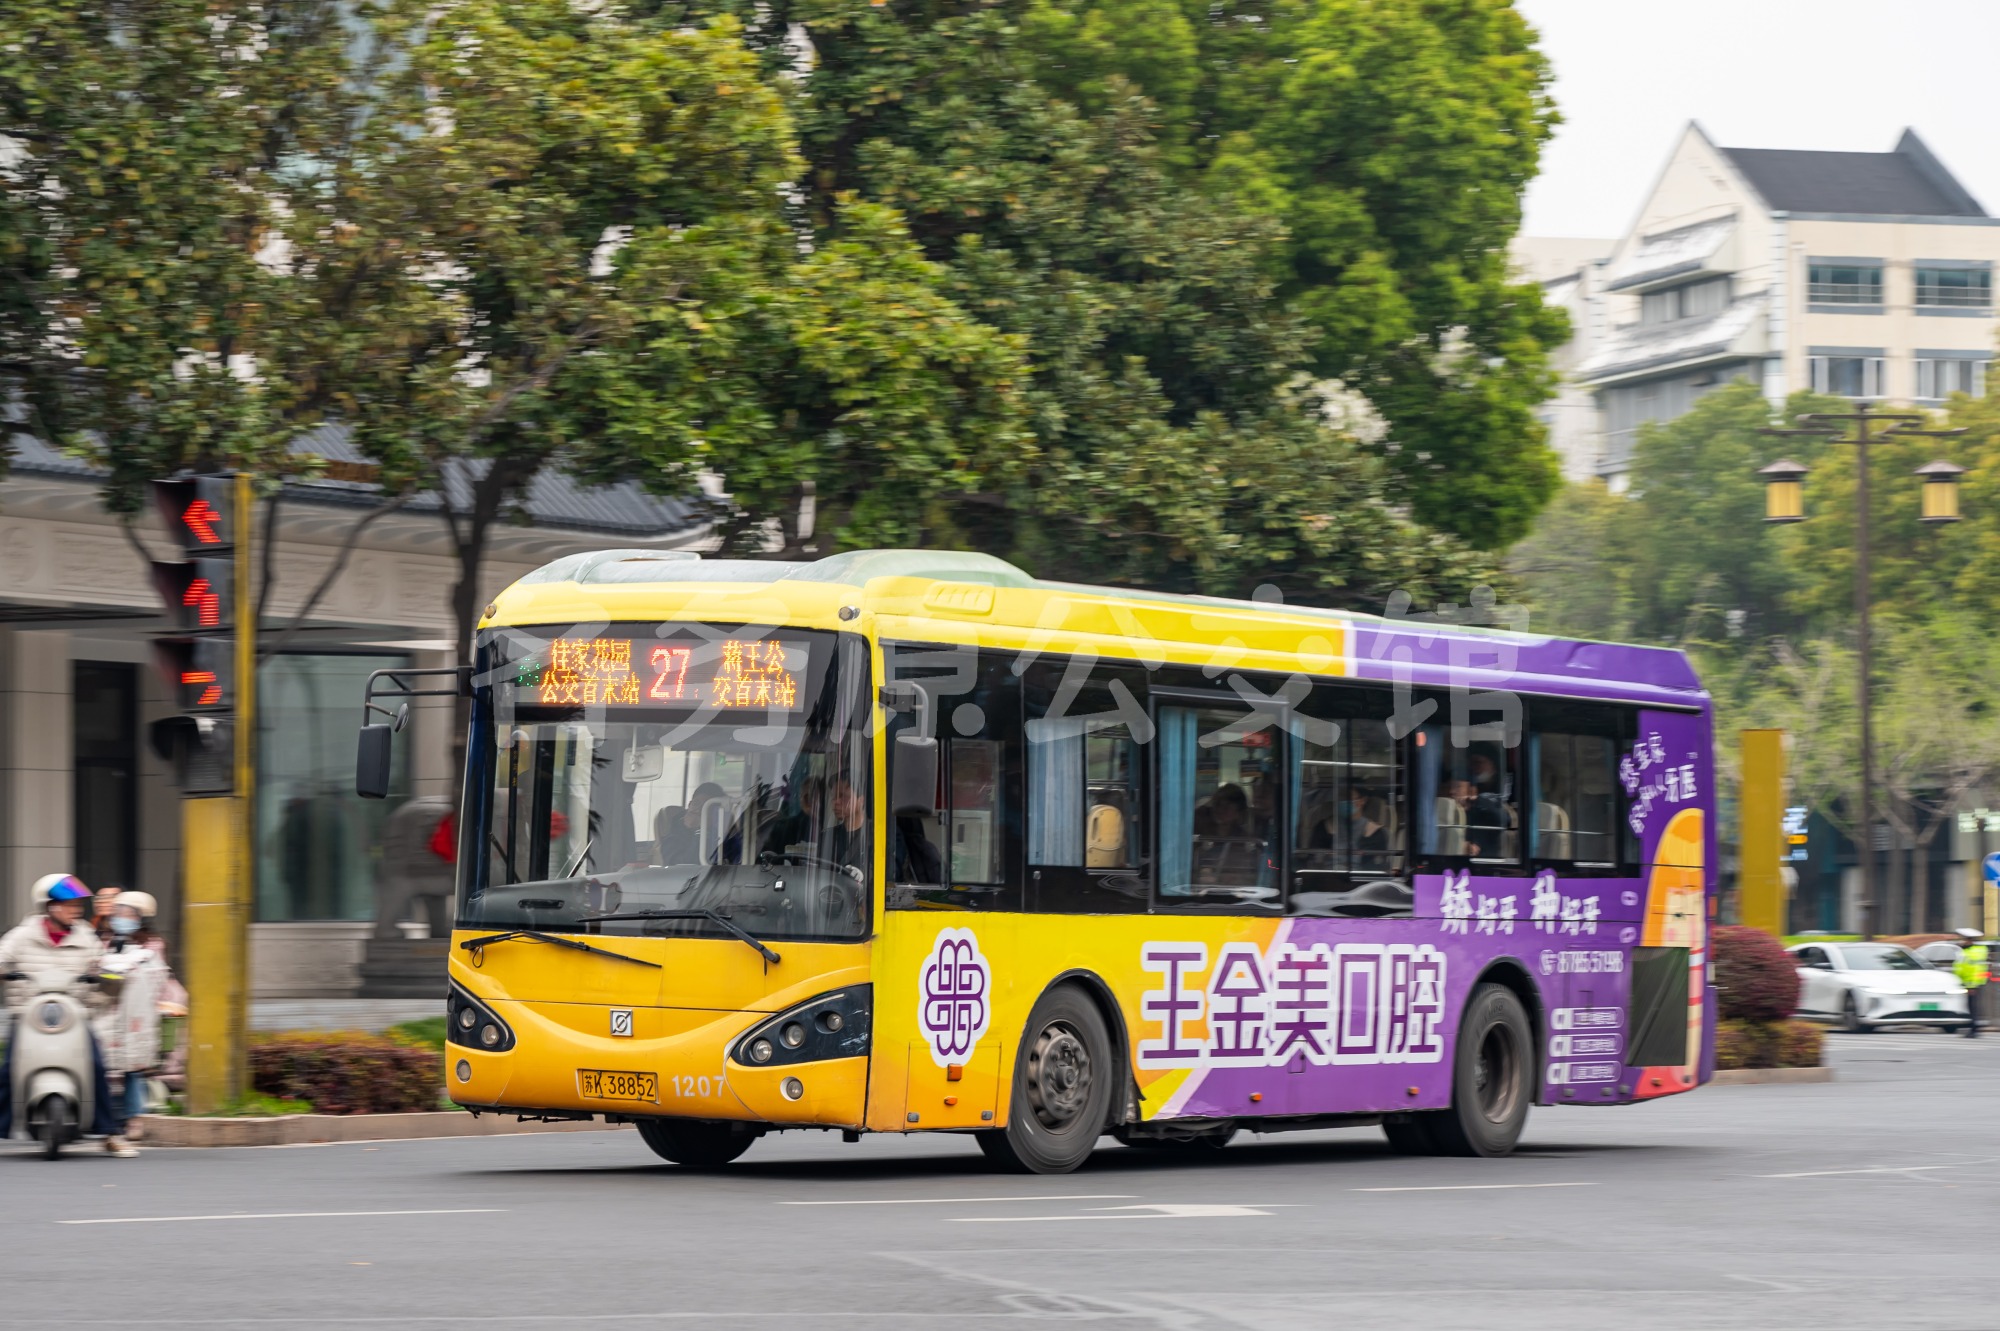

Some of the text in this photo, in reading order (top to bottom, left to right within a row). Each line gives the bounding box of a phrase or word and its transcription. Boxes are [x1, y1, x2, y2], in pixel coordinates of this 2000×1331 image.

[551, 639, 631, 672] 佳家花园
[722, 640, 786, 675] 蒋王公
[539, 671, 641, 705] 公交首末站
[650, 648, 691, 698] 27
[711, 674, 797, 707] 交首末站
[1138, 942, 1446, 1069] 王金美口腔
[672, 1074, 725, 1098] 1207
